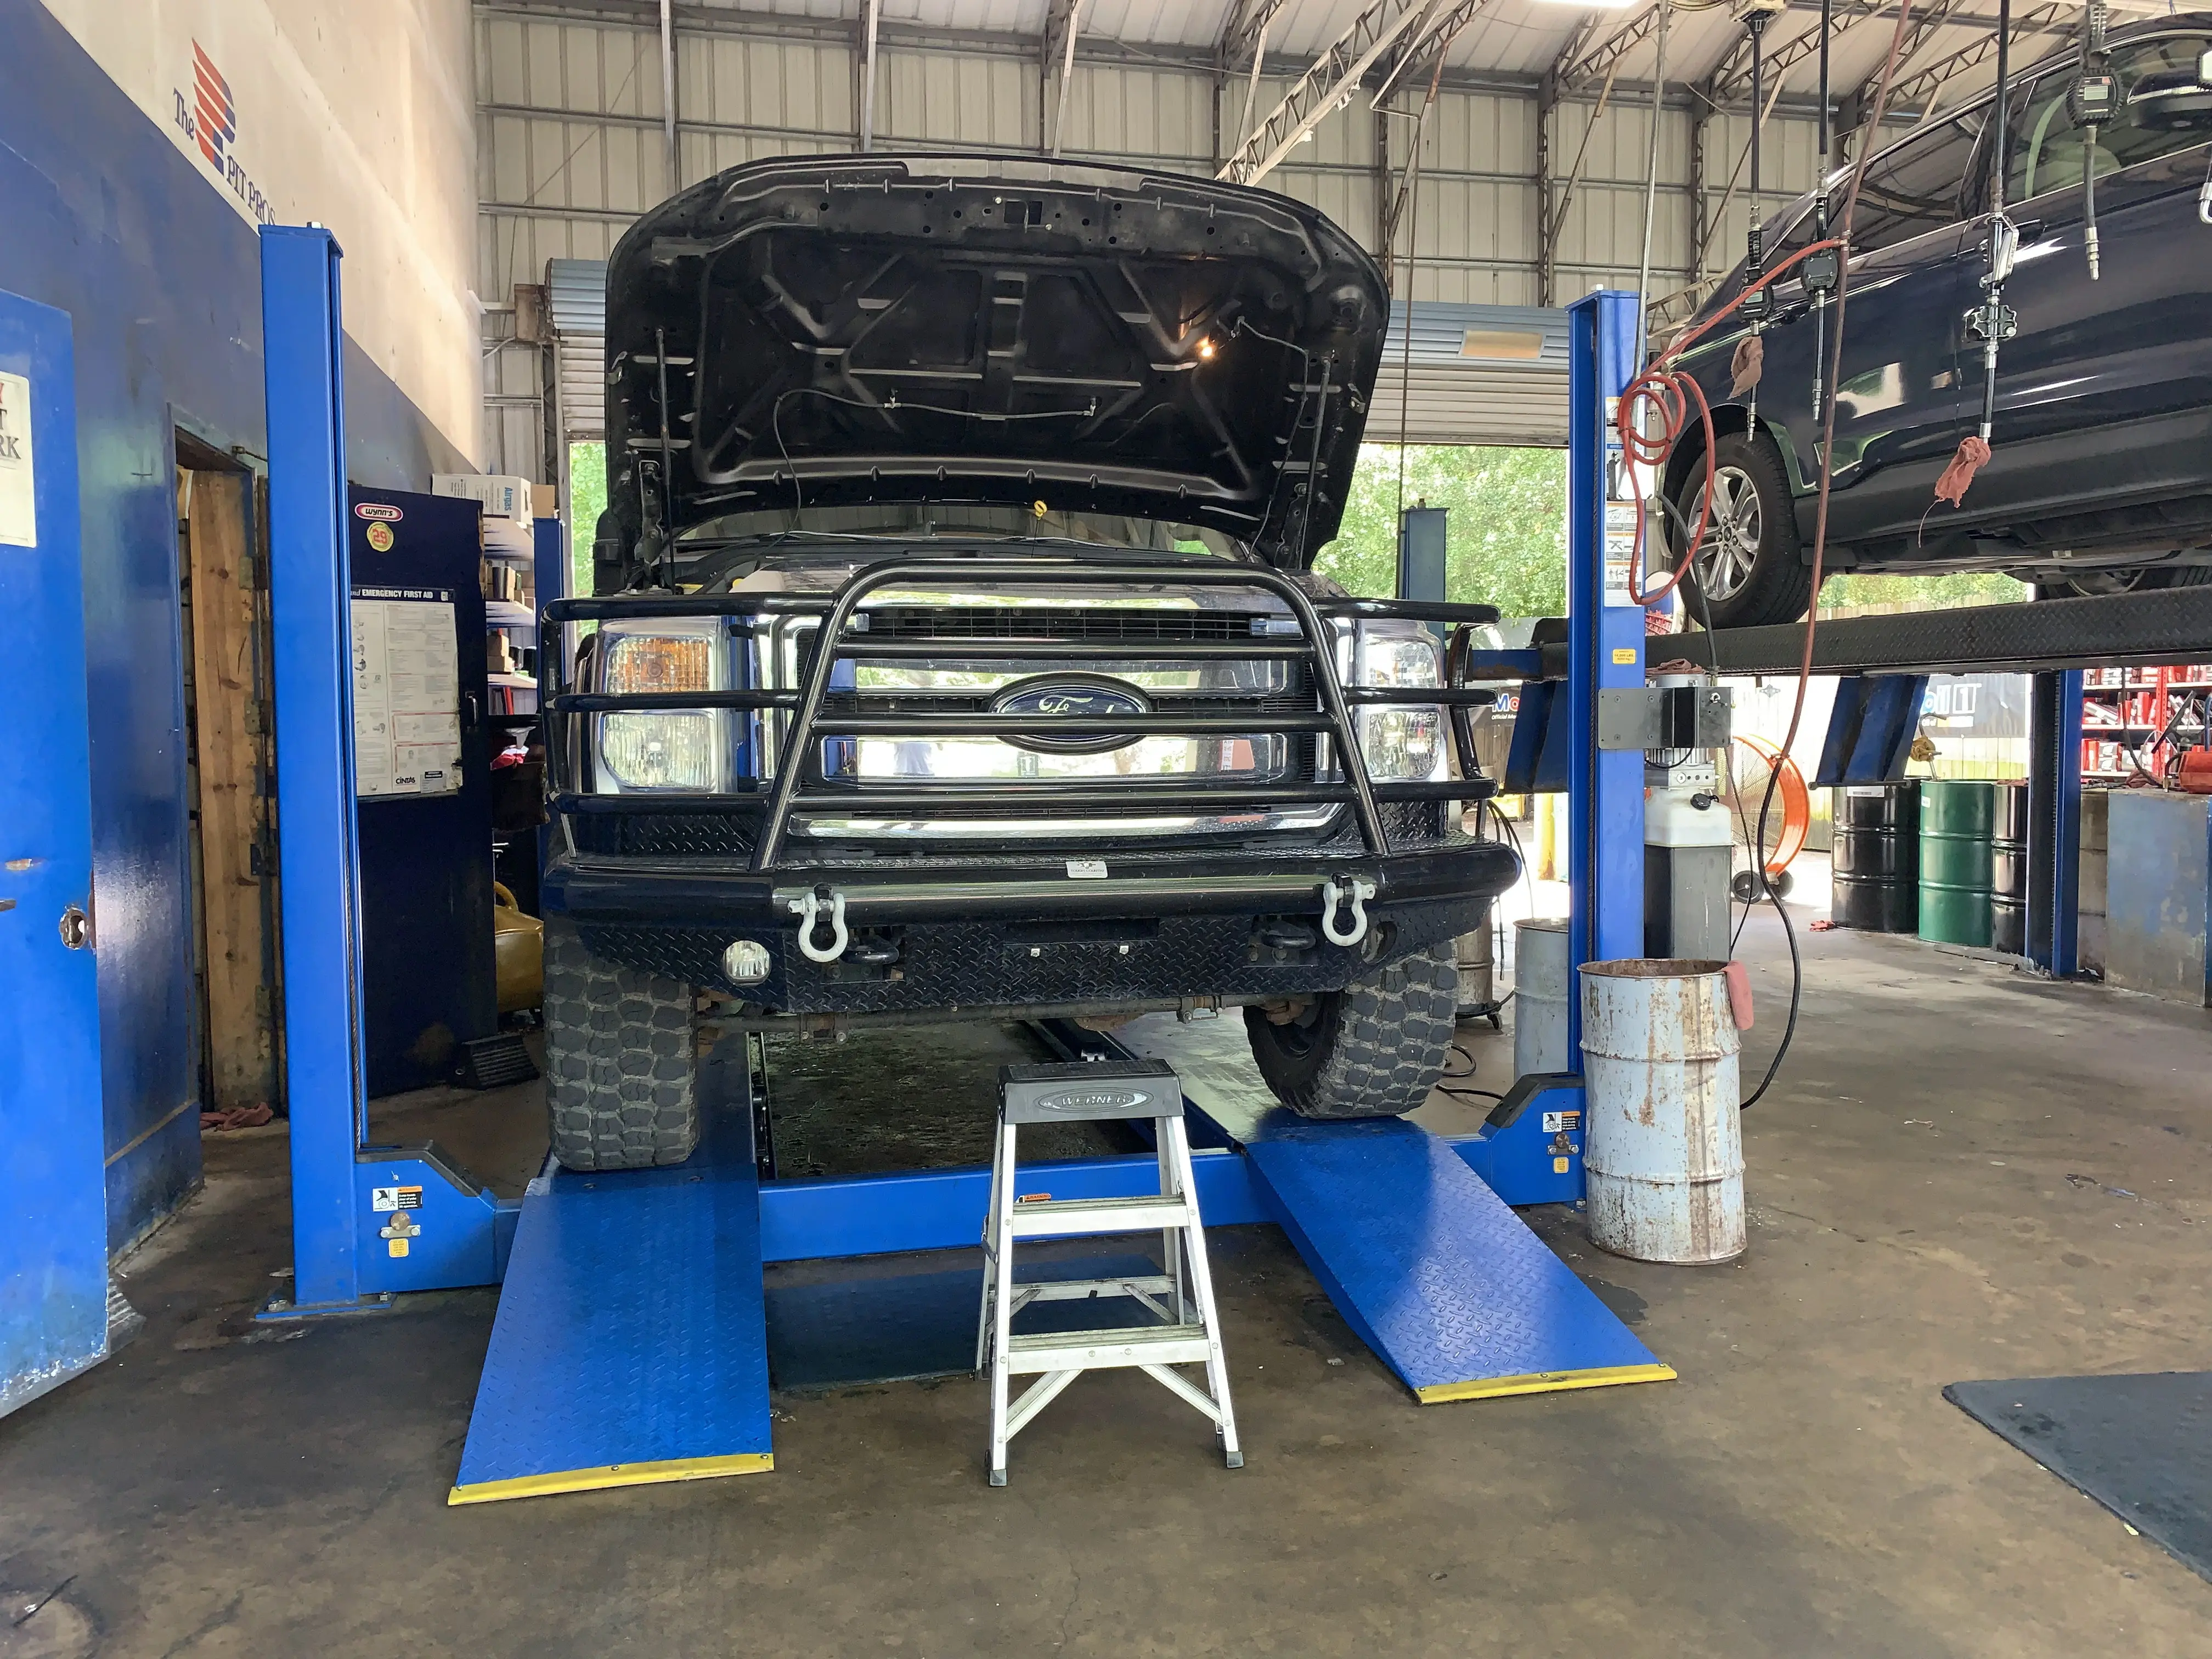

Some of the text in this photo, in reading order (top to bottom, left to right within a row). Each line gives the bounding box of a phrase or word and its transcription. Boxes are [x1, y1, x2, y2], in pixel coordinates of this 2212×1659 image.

[173, 87, 194, 141] The
[227, 155, 276, 226] PIT PROS
[504, 487, 513, 511] Airgas
[362, 589, 402, 597] EMERGENCY
[404, 590, 422, 599] FIRST
[423, 591, 433, 599] AID
[1062, 1094, 1126, 1106] WERNER
